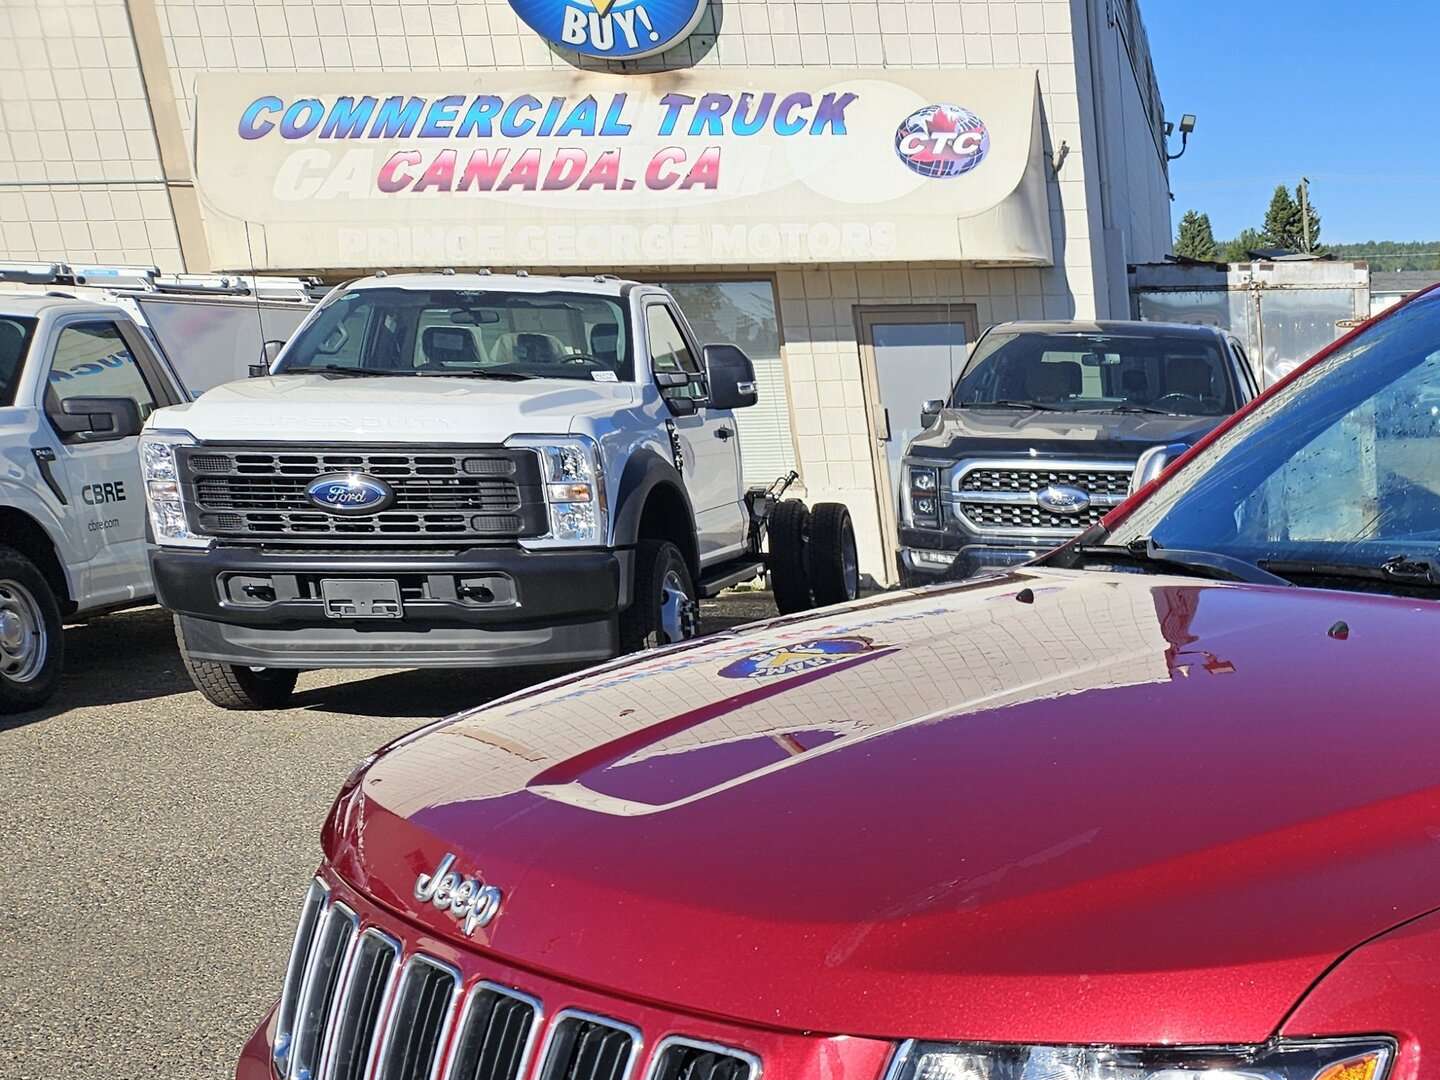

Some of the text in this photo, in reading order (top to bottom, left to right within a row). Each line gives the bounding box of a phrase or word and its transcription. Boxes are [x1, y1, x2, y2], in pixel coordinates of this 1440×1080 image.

[561, 5, 660, 51] BUY!
[238, 92, 859, 140] COMMERCIAL TRUCK
[899, 131, 982, 155] CTC
[376, 146, 721, 193] CANADA.CA
[518, 223, 700, 260] GEORGE
[711, 222, 897, 258] MOTORS
[81, 481, 127, 505] CBRE
[326, 485, 367, 503] Ford
[414, 852, 503, 936] Jeep
